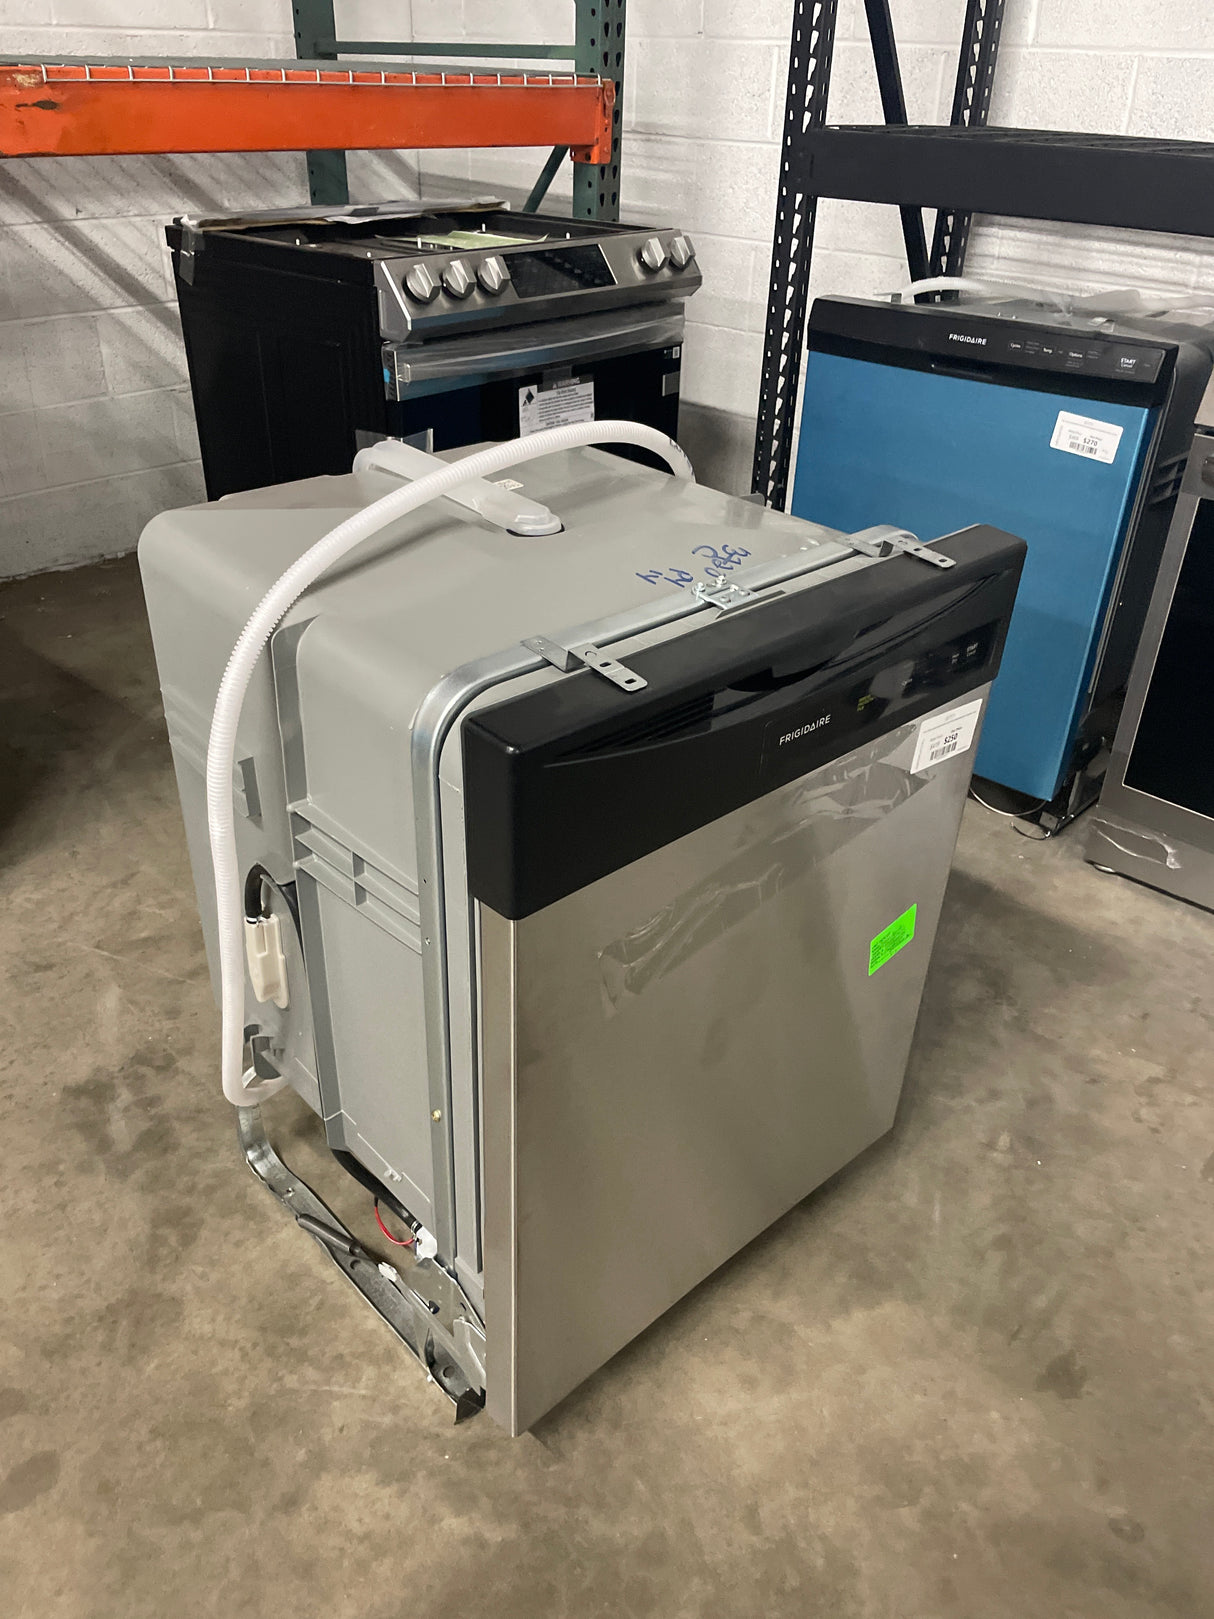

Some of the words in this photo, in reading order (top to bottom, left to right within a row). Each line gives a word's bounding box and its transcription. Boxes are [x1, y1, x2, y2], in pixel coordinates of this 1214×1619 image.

[948, 333, 987, 346] FRIGIDAIRE
[1083, 437, 1098, 447] $270
[779, 714, 831, 746] FRIGIDAIRE
[943, 732, 959, 745] $250
